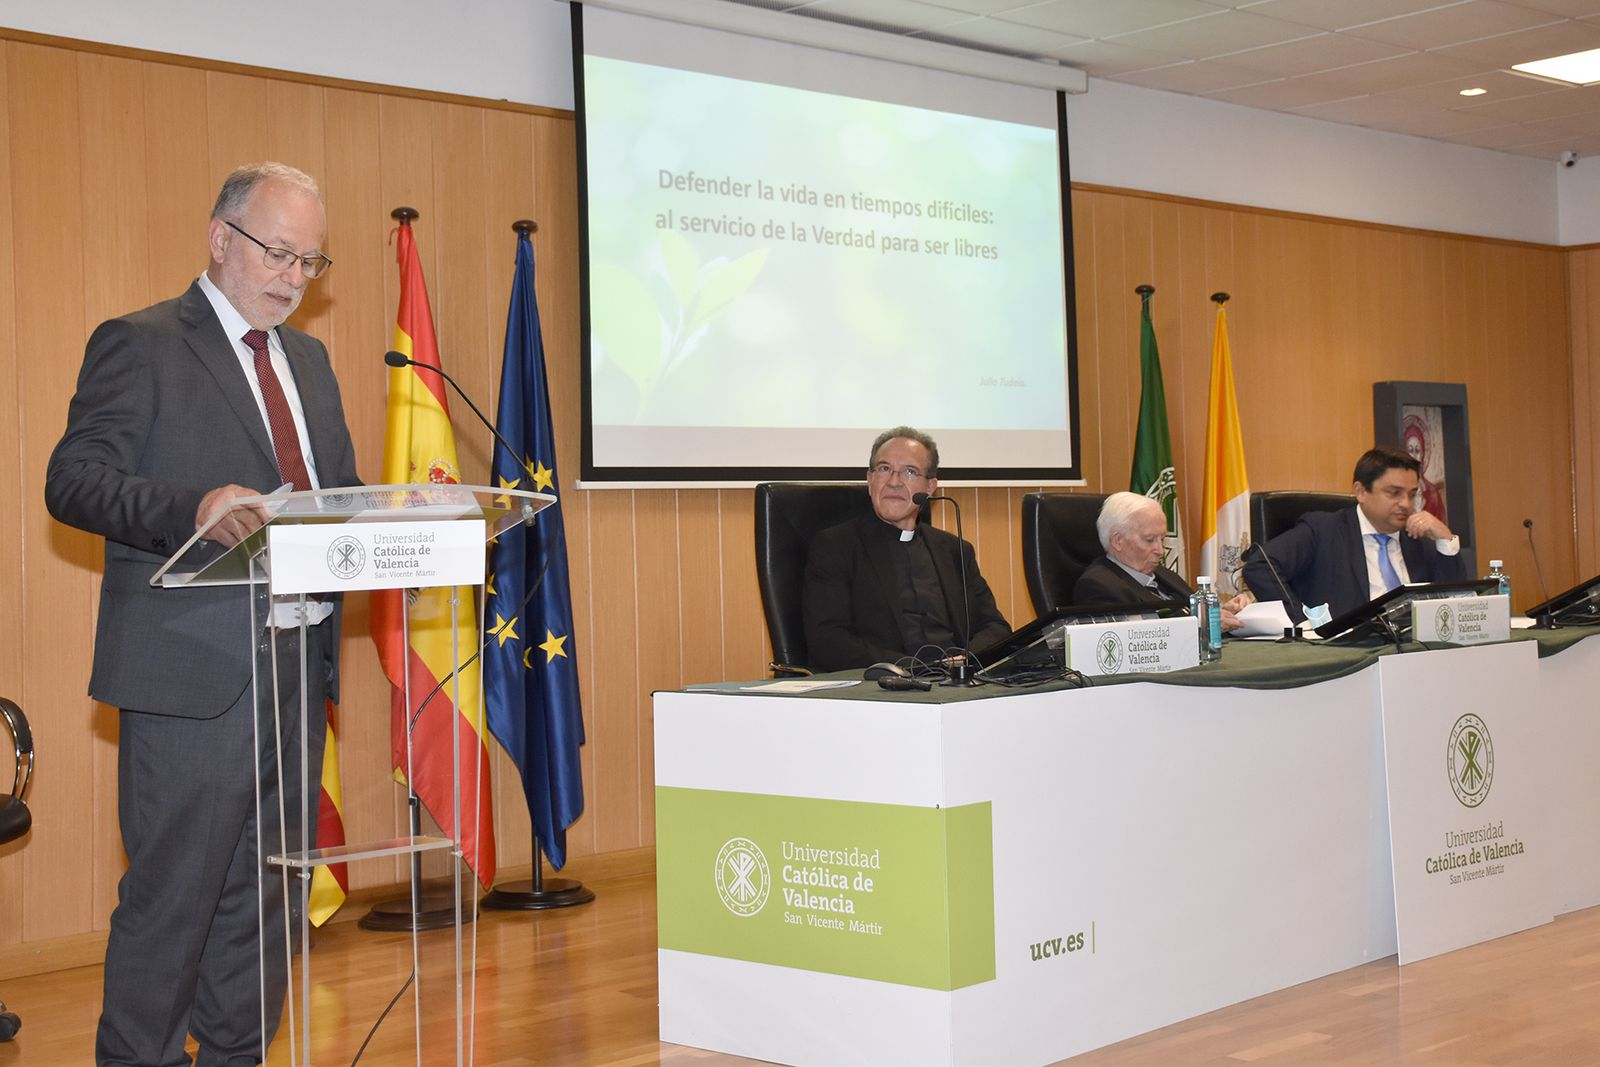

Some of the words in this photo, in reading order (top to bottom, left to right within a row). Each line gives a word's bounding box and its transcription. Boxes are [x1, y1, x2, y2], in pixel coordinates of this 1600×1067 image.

[658, 169, 752, 199] Defender
[757, 180, 774, 200] la
[780, 185, 818, 206] vida
[823, 194, 845, 209] en
[851, 192, 922, 218] tiempos
[927, 200, 994, 225] difíciles:
[655, 209, 673, 229] al
[680, 213, 756, 238] servicio
[761, 219, 786, 240] de
[791, 222, 807, 243] la
[812, 225, 875, 249] Verdad
[881, 234, 919, 254] para
[924, 241, 949, 255] ser
[954, 238, 998, 260] libres
[373, 532, 435, 544] Universidad
[373, 545, 416, 557] Católica
[418, 545, 431, 555] de
[374, 558, 419, 569] Valencia
[374, 571, 387, 579] San
[389, 570, 413, 578] Vicente
[1458, 612, 1479, 622] Católica
[1480, 611, 1487, 621] de
[1128, 626, 1170, 640] Universidad
[1458, 623, 1481, 632] Valencia
[1128, 640, 1158, 652] Católica
[1158, 639, 1168, 650] de
[1128, 653, 1160, 665] Valencia
[1445, 820, 1504, 849] Universidad
[782, 841, 881, 870] Universidad
[1425, 852, 1467, 874] Católica
[1469, 847, 1481, 865] de
[1482, 838, 1525, 863] Valencia
[782, 865, 849, 890] Católica
[853, 871, 874, 892] de
[1449, 873, 1462, 885] San
[1462, 867, 1485, 882] Vicente
[782, 887, 855, 914] Valencia
[784, 911, 803, 925] San
[806, 914, 845, 930] Vicente
[849, 920, 883, 935] Mártir
[1029, 931, 1085, 962] ucv.es
